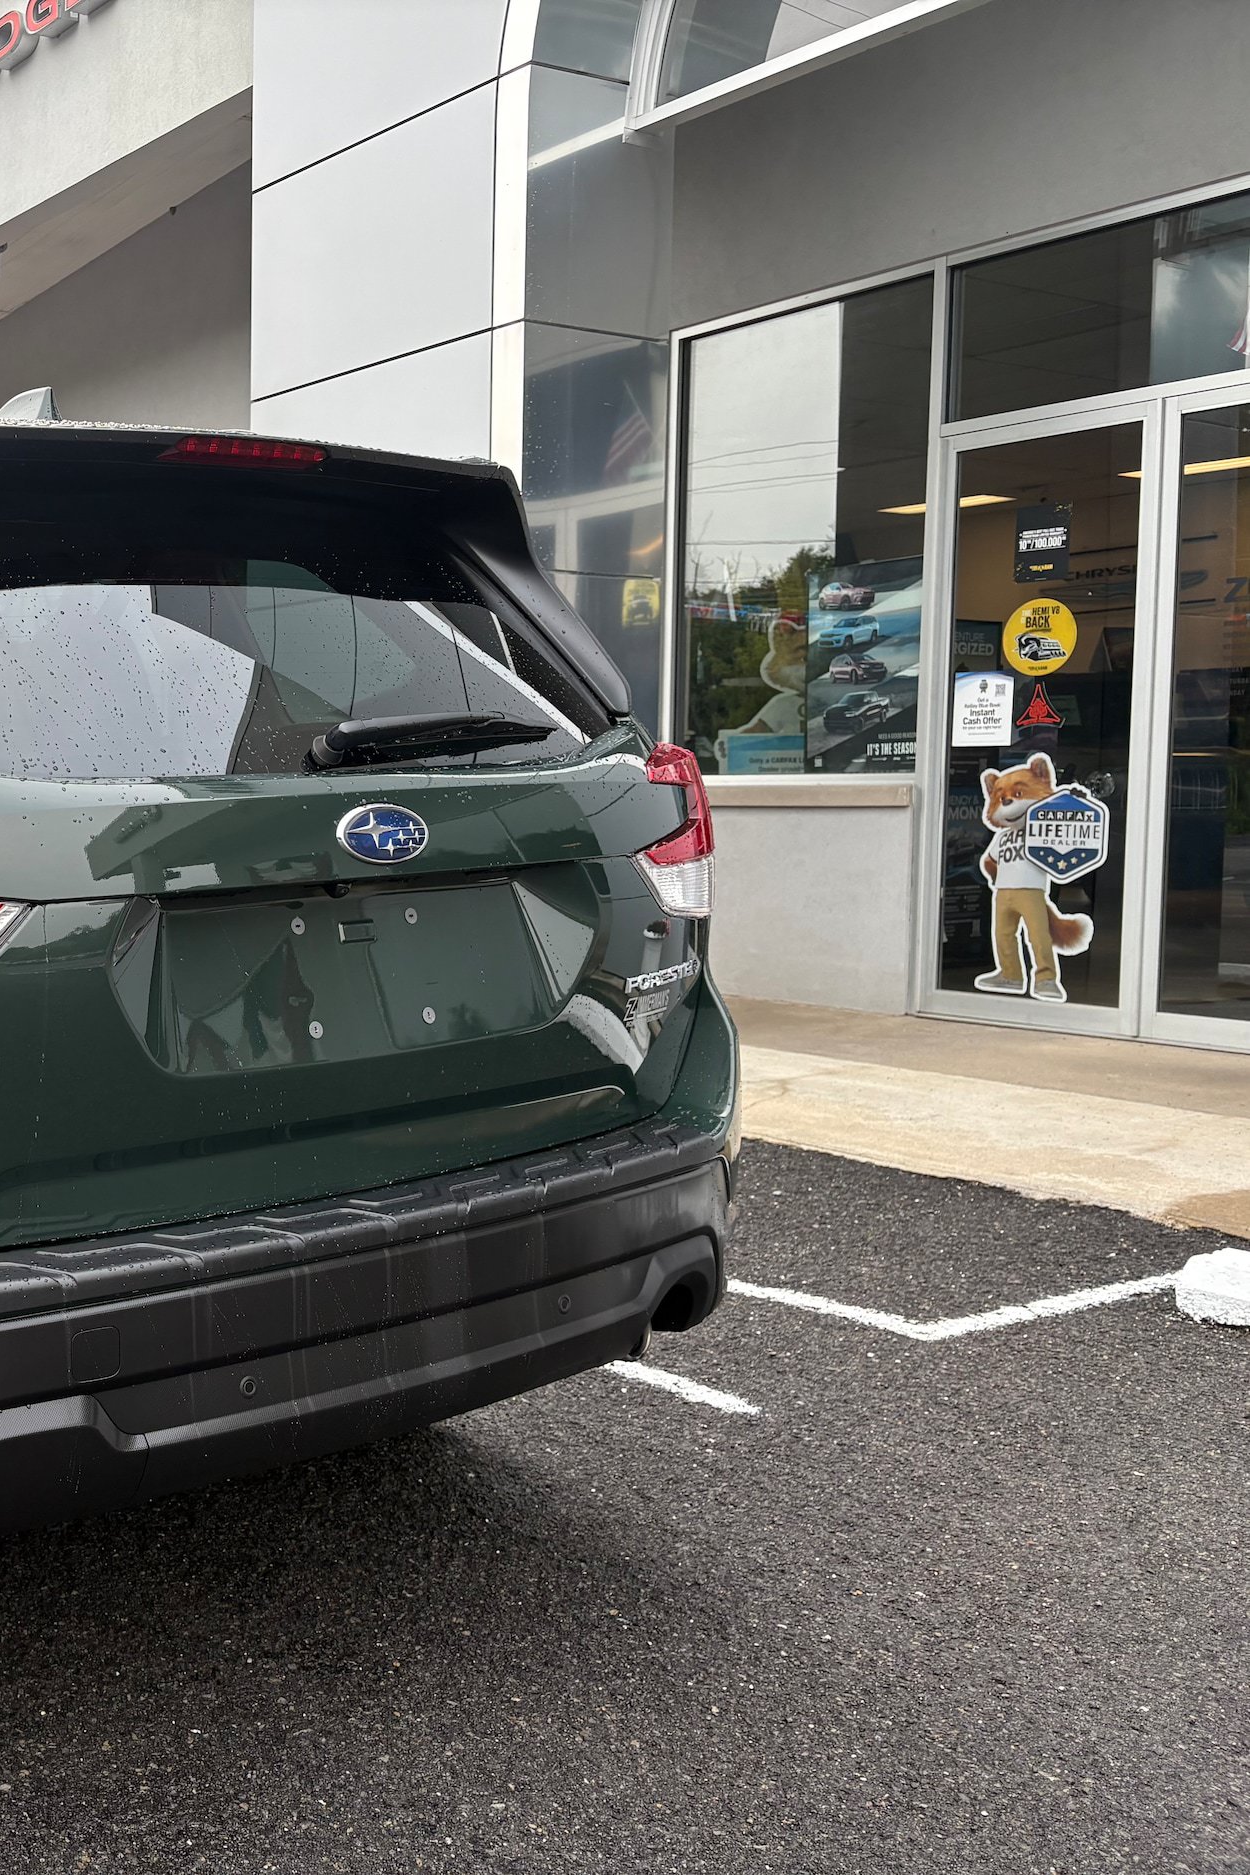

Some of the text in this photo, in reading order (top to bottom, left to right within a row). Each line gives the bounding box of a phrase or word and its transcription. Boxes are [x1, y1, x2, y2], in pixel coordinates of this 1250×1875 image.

[1032, 606, 1050, 616] HEMI
[1051, 605, 1060, 614] V8
[1026, 615, 1050, 628] BACK
[963, 716, 1001, 725] Cash Offer
[867, 743, 880, 756] IT'S
[881, 742, 892, 755] THE
[1037, 810, 1094, 821] CARFAX
[1029, 823, 1100, 840] LIFETIME
[999, 829, 1025, 848] CAR
[998, 845, 1025, 866] FOX
